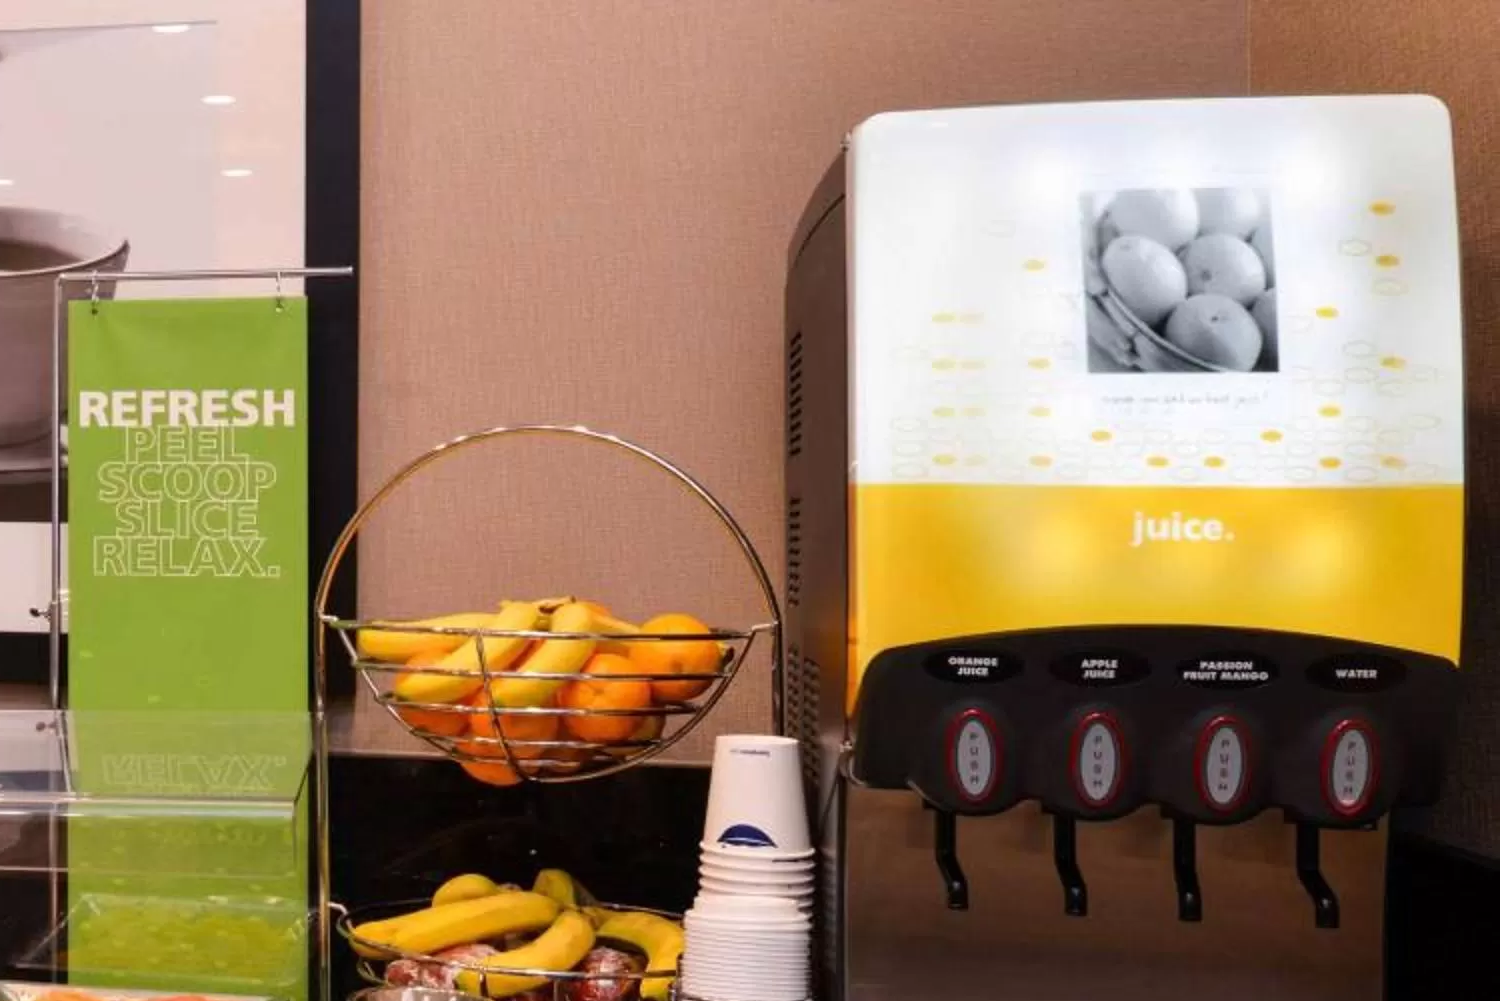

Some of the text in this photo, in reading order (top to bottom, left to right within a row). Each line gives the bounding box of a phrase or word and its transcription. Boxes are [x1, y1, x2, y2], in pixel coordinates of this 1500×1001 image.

[79, 389, 296, 428] REFRESH
[125, 425, 249, 464] PEEL
[98, 461, 277, 502] SCOOP
[115, 499, 260, 539] SLICE
[1129, 511, 1235, 547] juice.
[94, 535, 281, 577] RELAX.
[948, 656, 999, 668] ORANGE
[1080, 659, 1119, 670] APPLE
[1199, 661, 1253, 671] PASSION
[957, 666, 989, 677] JUICE
[1083, 669, 1116, 680] JUICE
[1183, 670, 1269, 682] FRUIT MANGO
[1335, 668, 1377, 680] WATER
